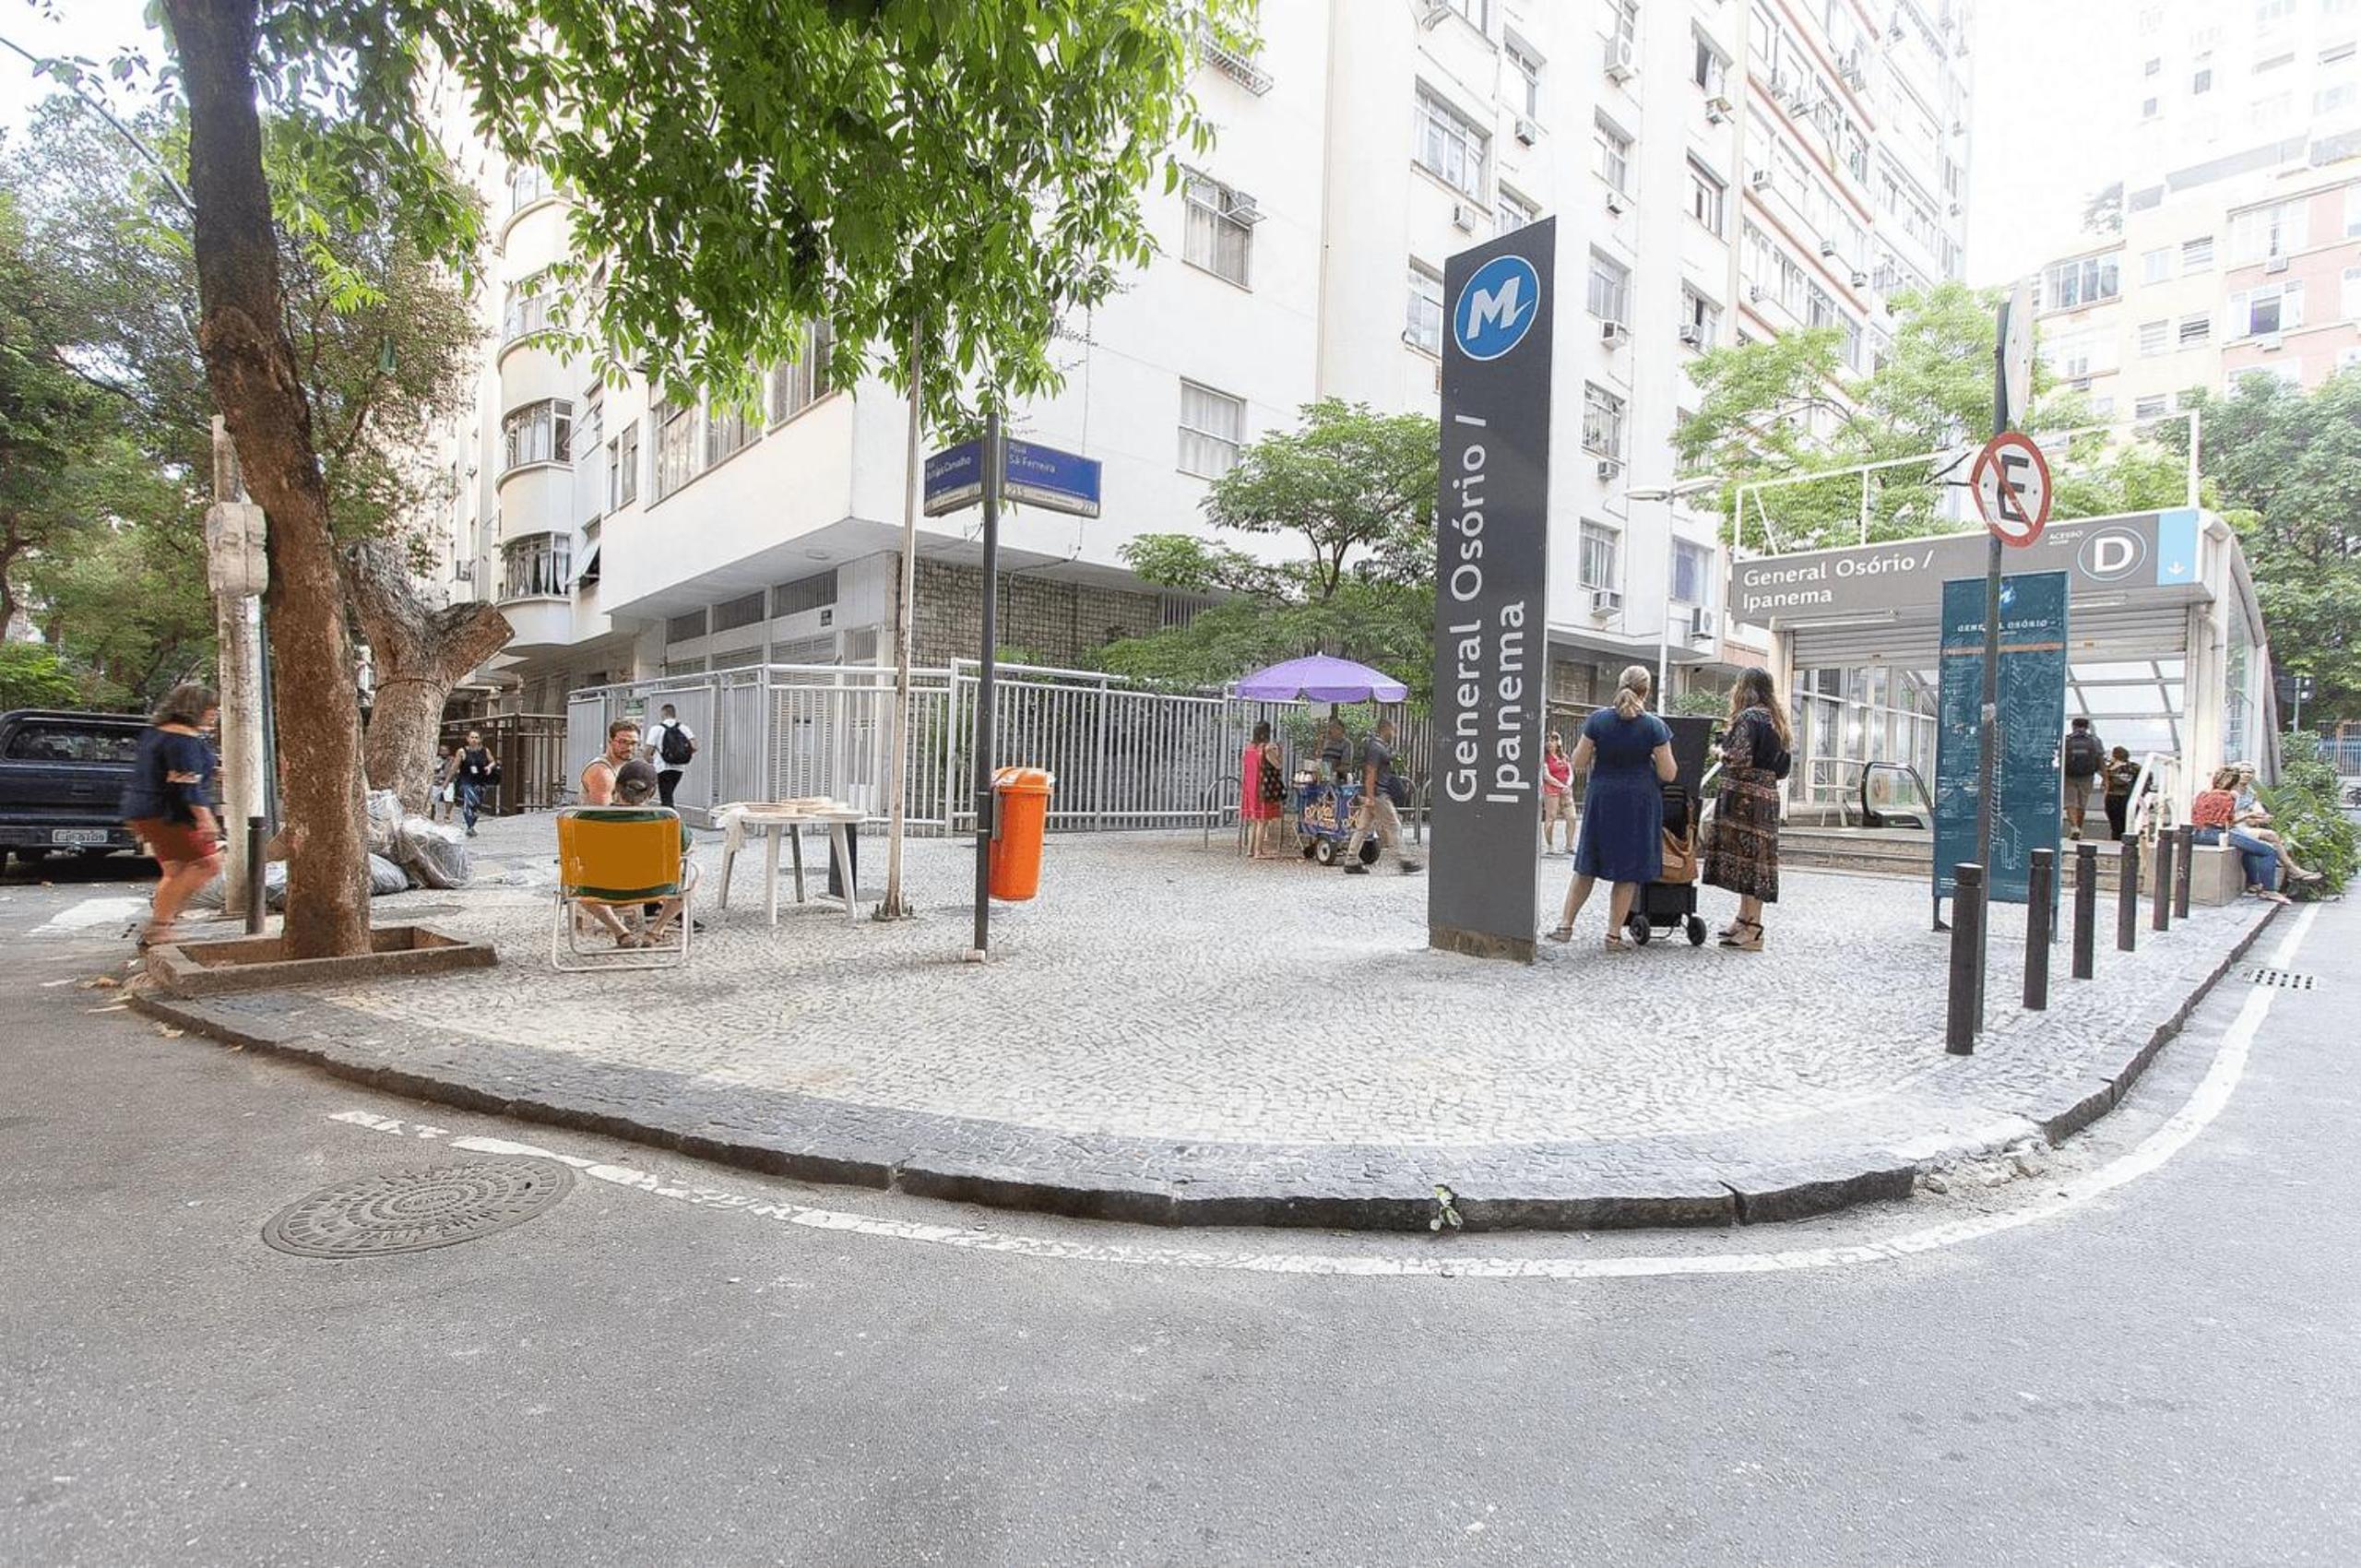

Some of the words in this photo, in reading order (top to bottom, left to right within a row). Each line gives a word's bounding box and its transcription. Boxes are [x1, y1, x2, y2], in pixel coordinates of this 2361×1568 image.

[1466, 276, 1534, 340] M
[1022, 456, 1056, 473] Ferreira
[1998, 454, 2030, 523] E
[1451, 444, 1487, 601] Osório
[1743, 561, 1826, 588] General
[1835, 554, 1916, 577] Osório
[2094, 536, 2133, 573] D
[1743, 588, 1833, 612] Ipanema
[1957, 622, 2004, 633] GENEL
[1445, 620, 1481, 802] General
[1486, 600, 1531, 803] Ipanema
